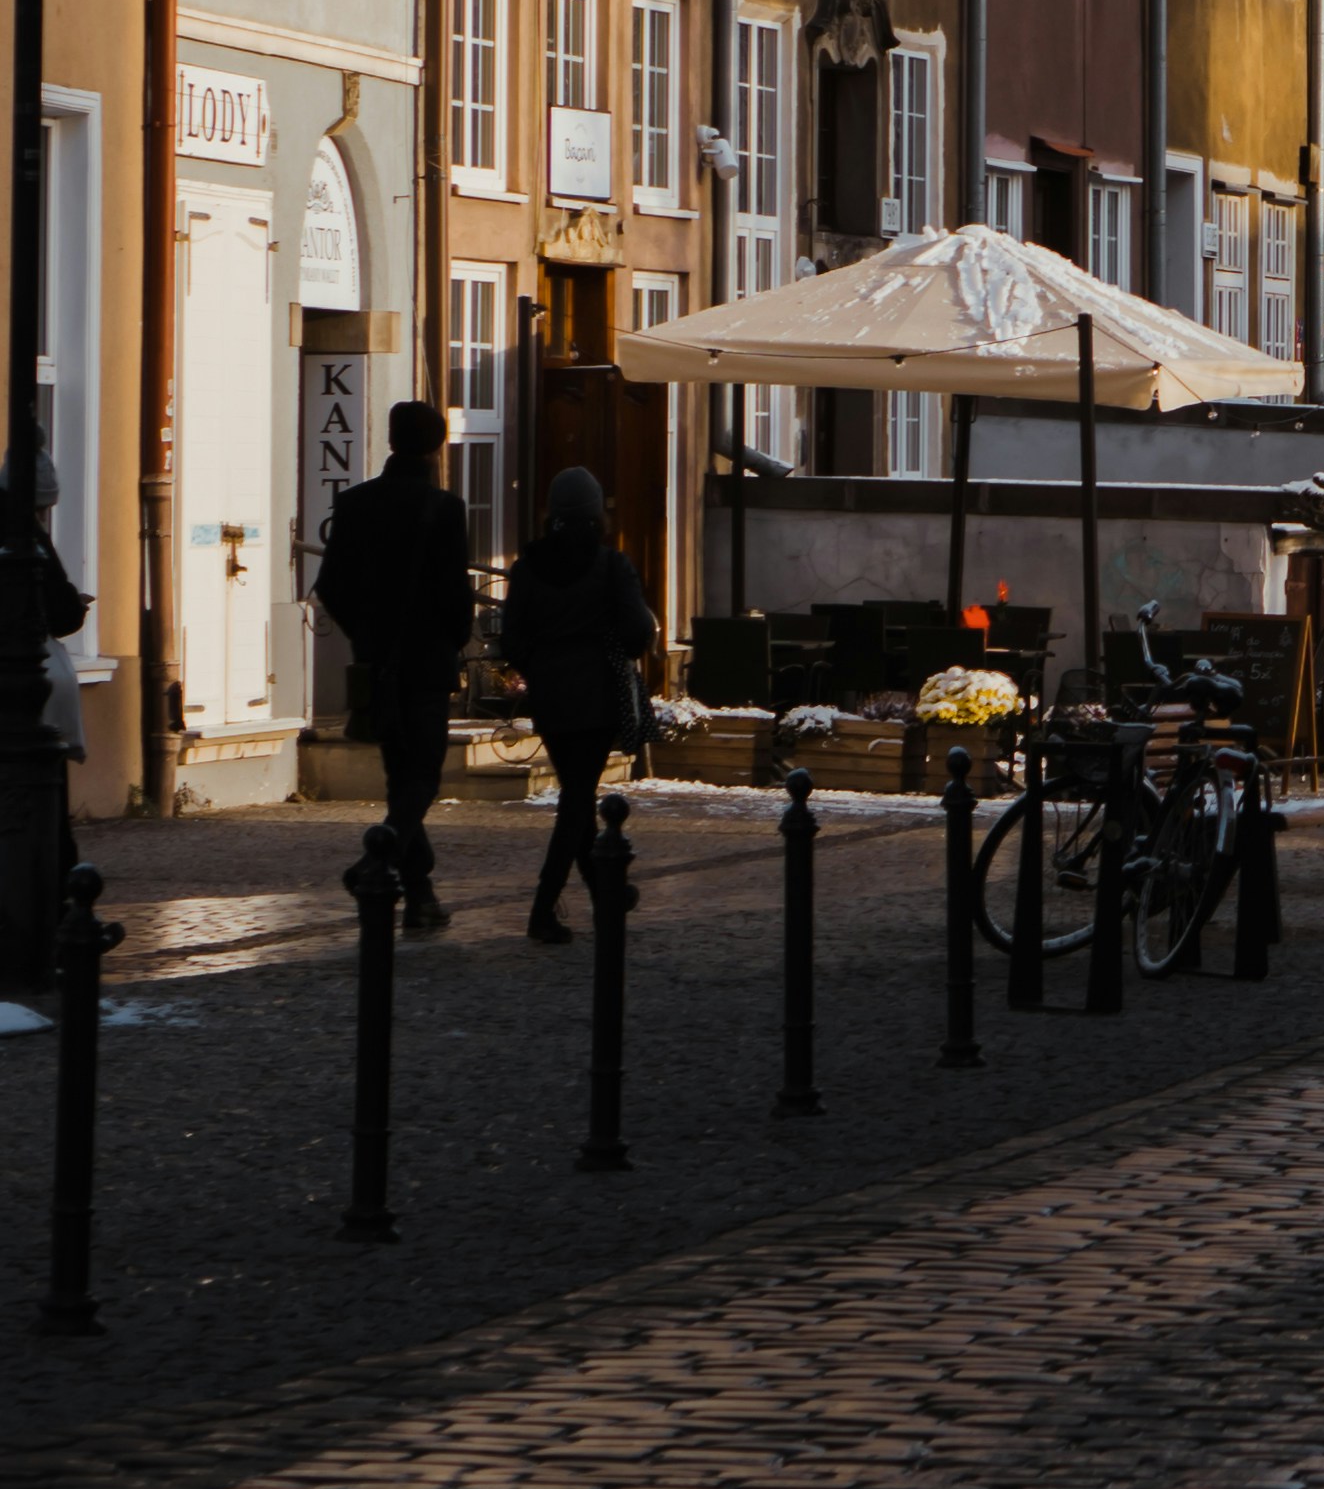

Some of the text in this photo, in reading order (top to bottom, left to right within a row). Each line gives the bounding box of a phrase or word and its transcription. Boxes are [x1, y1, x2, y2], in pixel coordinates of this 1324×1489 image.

[187, 82, 251, 146] LODY
[300, 226, 342, 262] ANTOR
[319, 364, 353, 545] KANT
